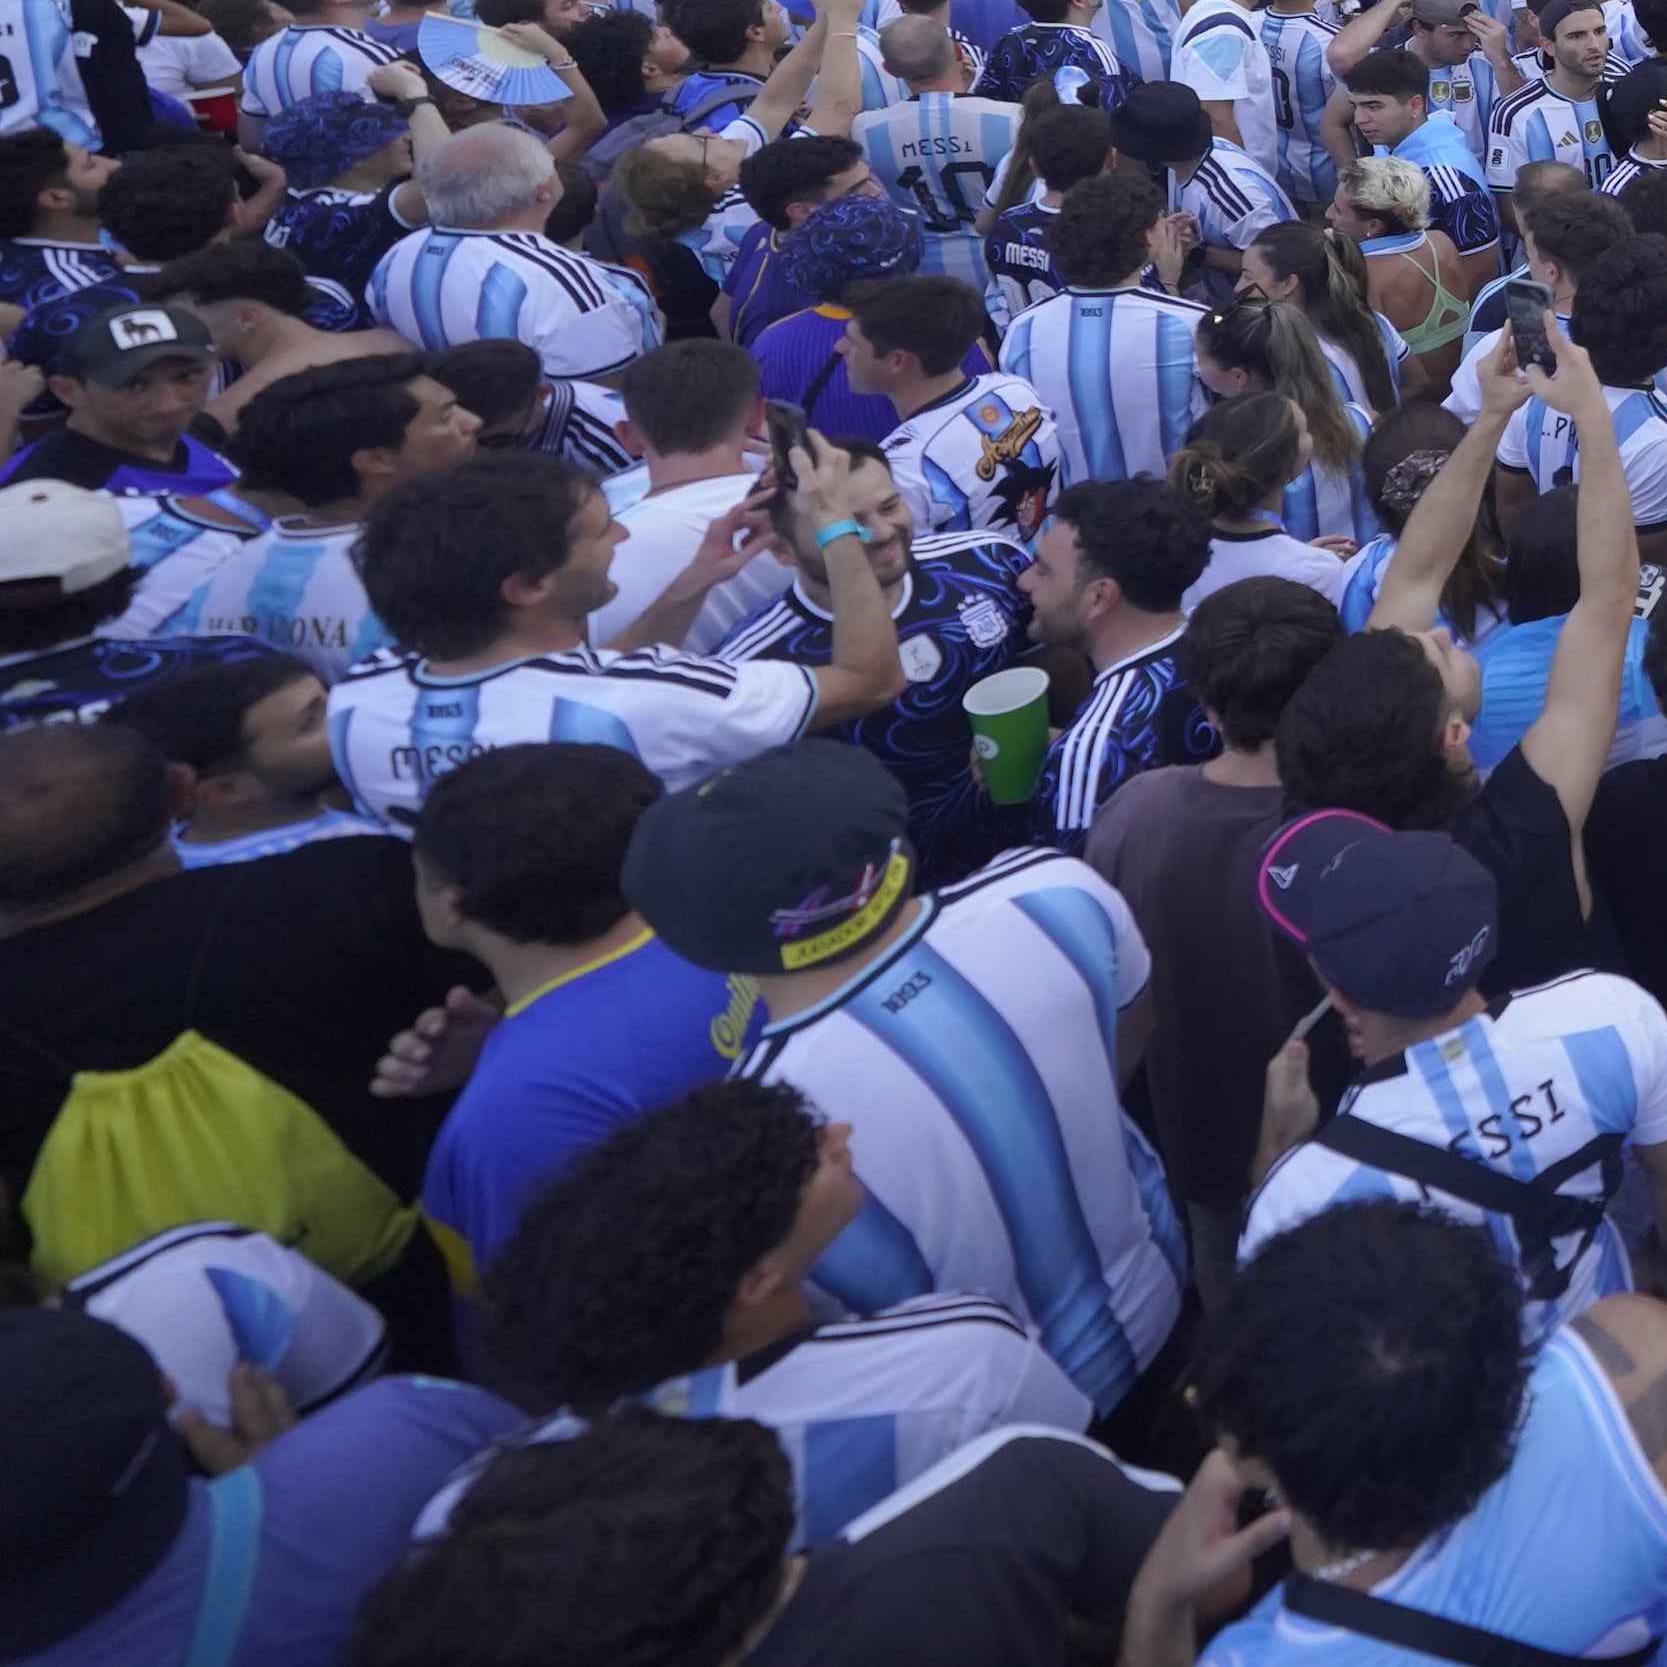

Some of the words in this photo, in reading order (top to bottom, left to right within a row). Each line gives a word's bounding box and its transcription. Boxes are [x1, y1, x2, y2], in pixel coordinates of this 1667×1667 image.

[1263, 42, 1286, 63] SSI
[902, 136, 974, 158] MESSI
[1005, 240, 1051, 273] MESSI
[391, 743, 498, 781] MESS
[1448, 1077, 1566, 1160] SSI
